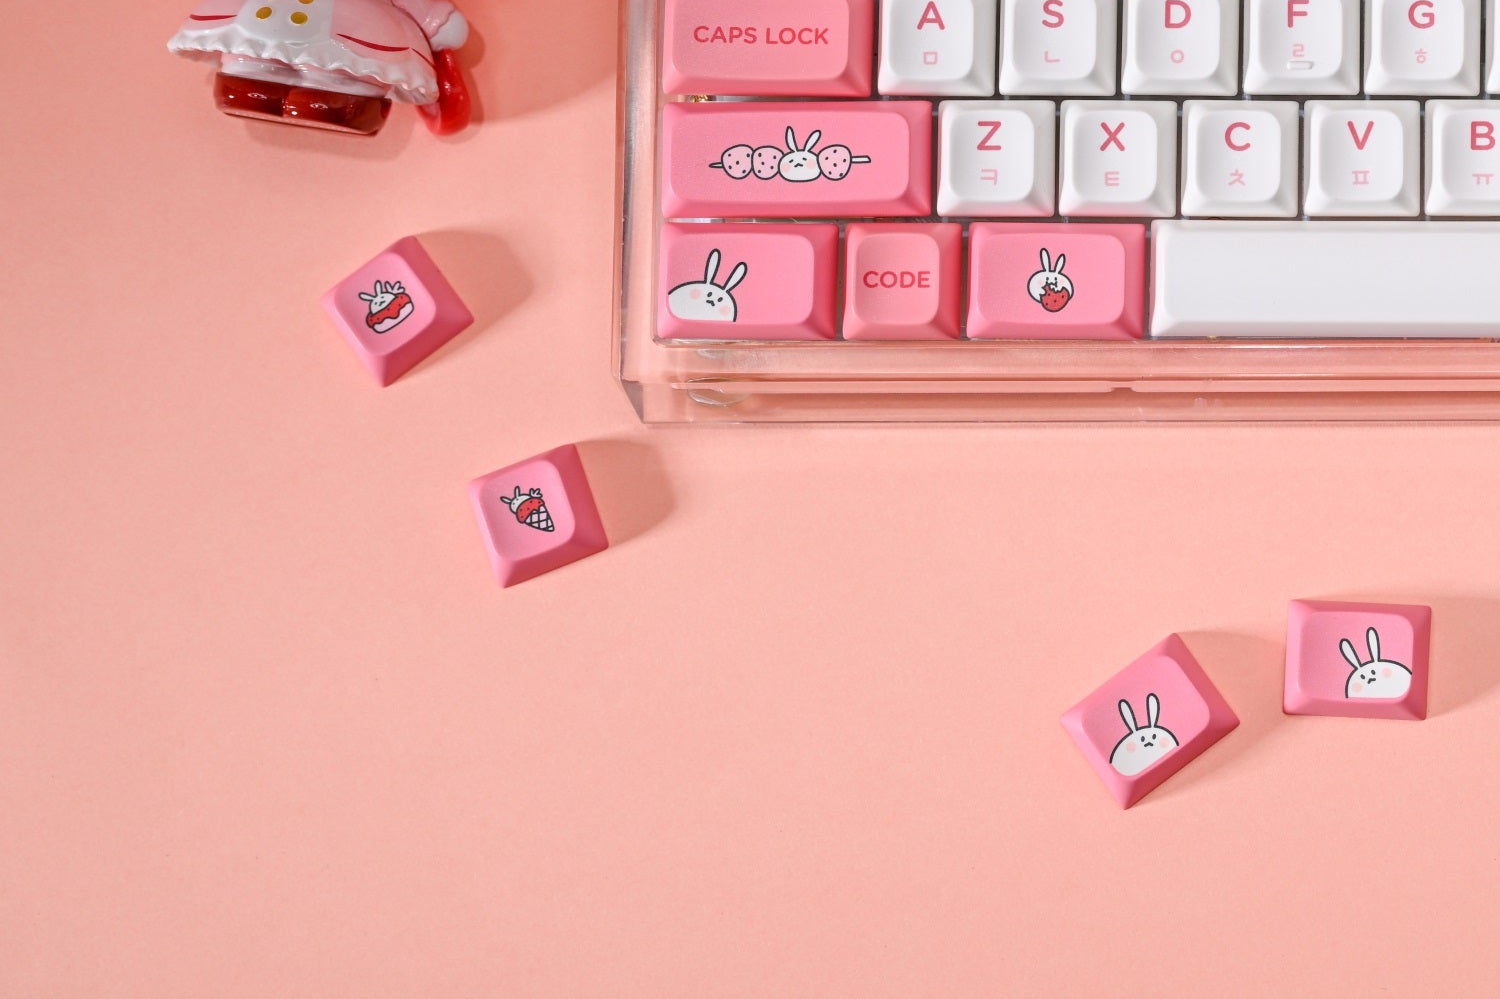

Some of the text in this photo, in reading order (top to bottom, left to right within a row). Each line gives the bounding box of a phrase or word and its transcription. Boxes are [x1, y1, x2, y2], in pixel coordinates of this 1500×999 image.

[916, 0, 946, 31] A
[1164, 0, 1192, 29] D
[1407, 0, 1435, 30] G
[693, 25, 829, 45] CAPS LOCK
[976, 120, 1002, 151] Z
[1099, 121, 1126, 152] X
[1224, 121, 1251, 152] C
[1347, 120, 1375, 151] V
[1470, 120, 1496, 151] B
[862, 270, 930, 289] CODE
